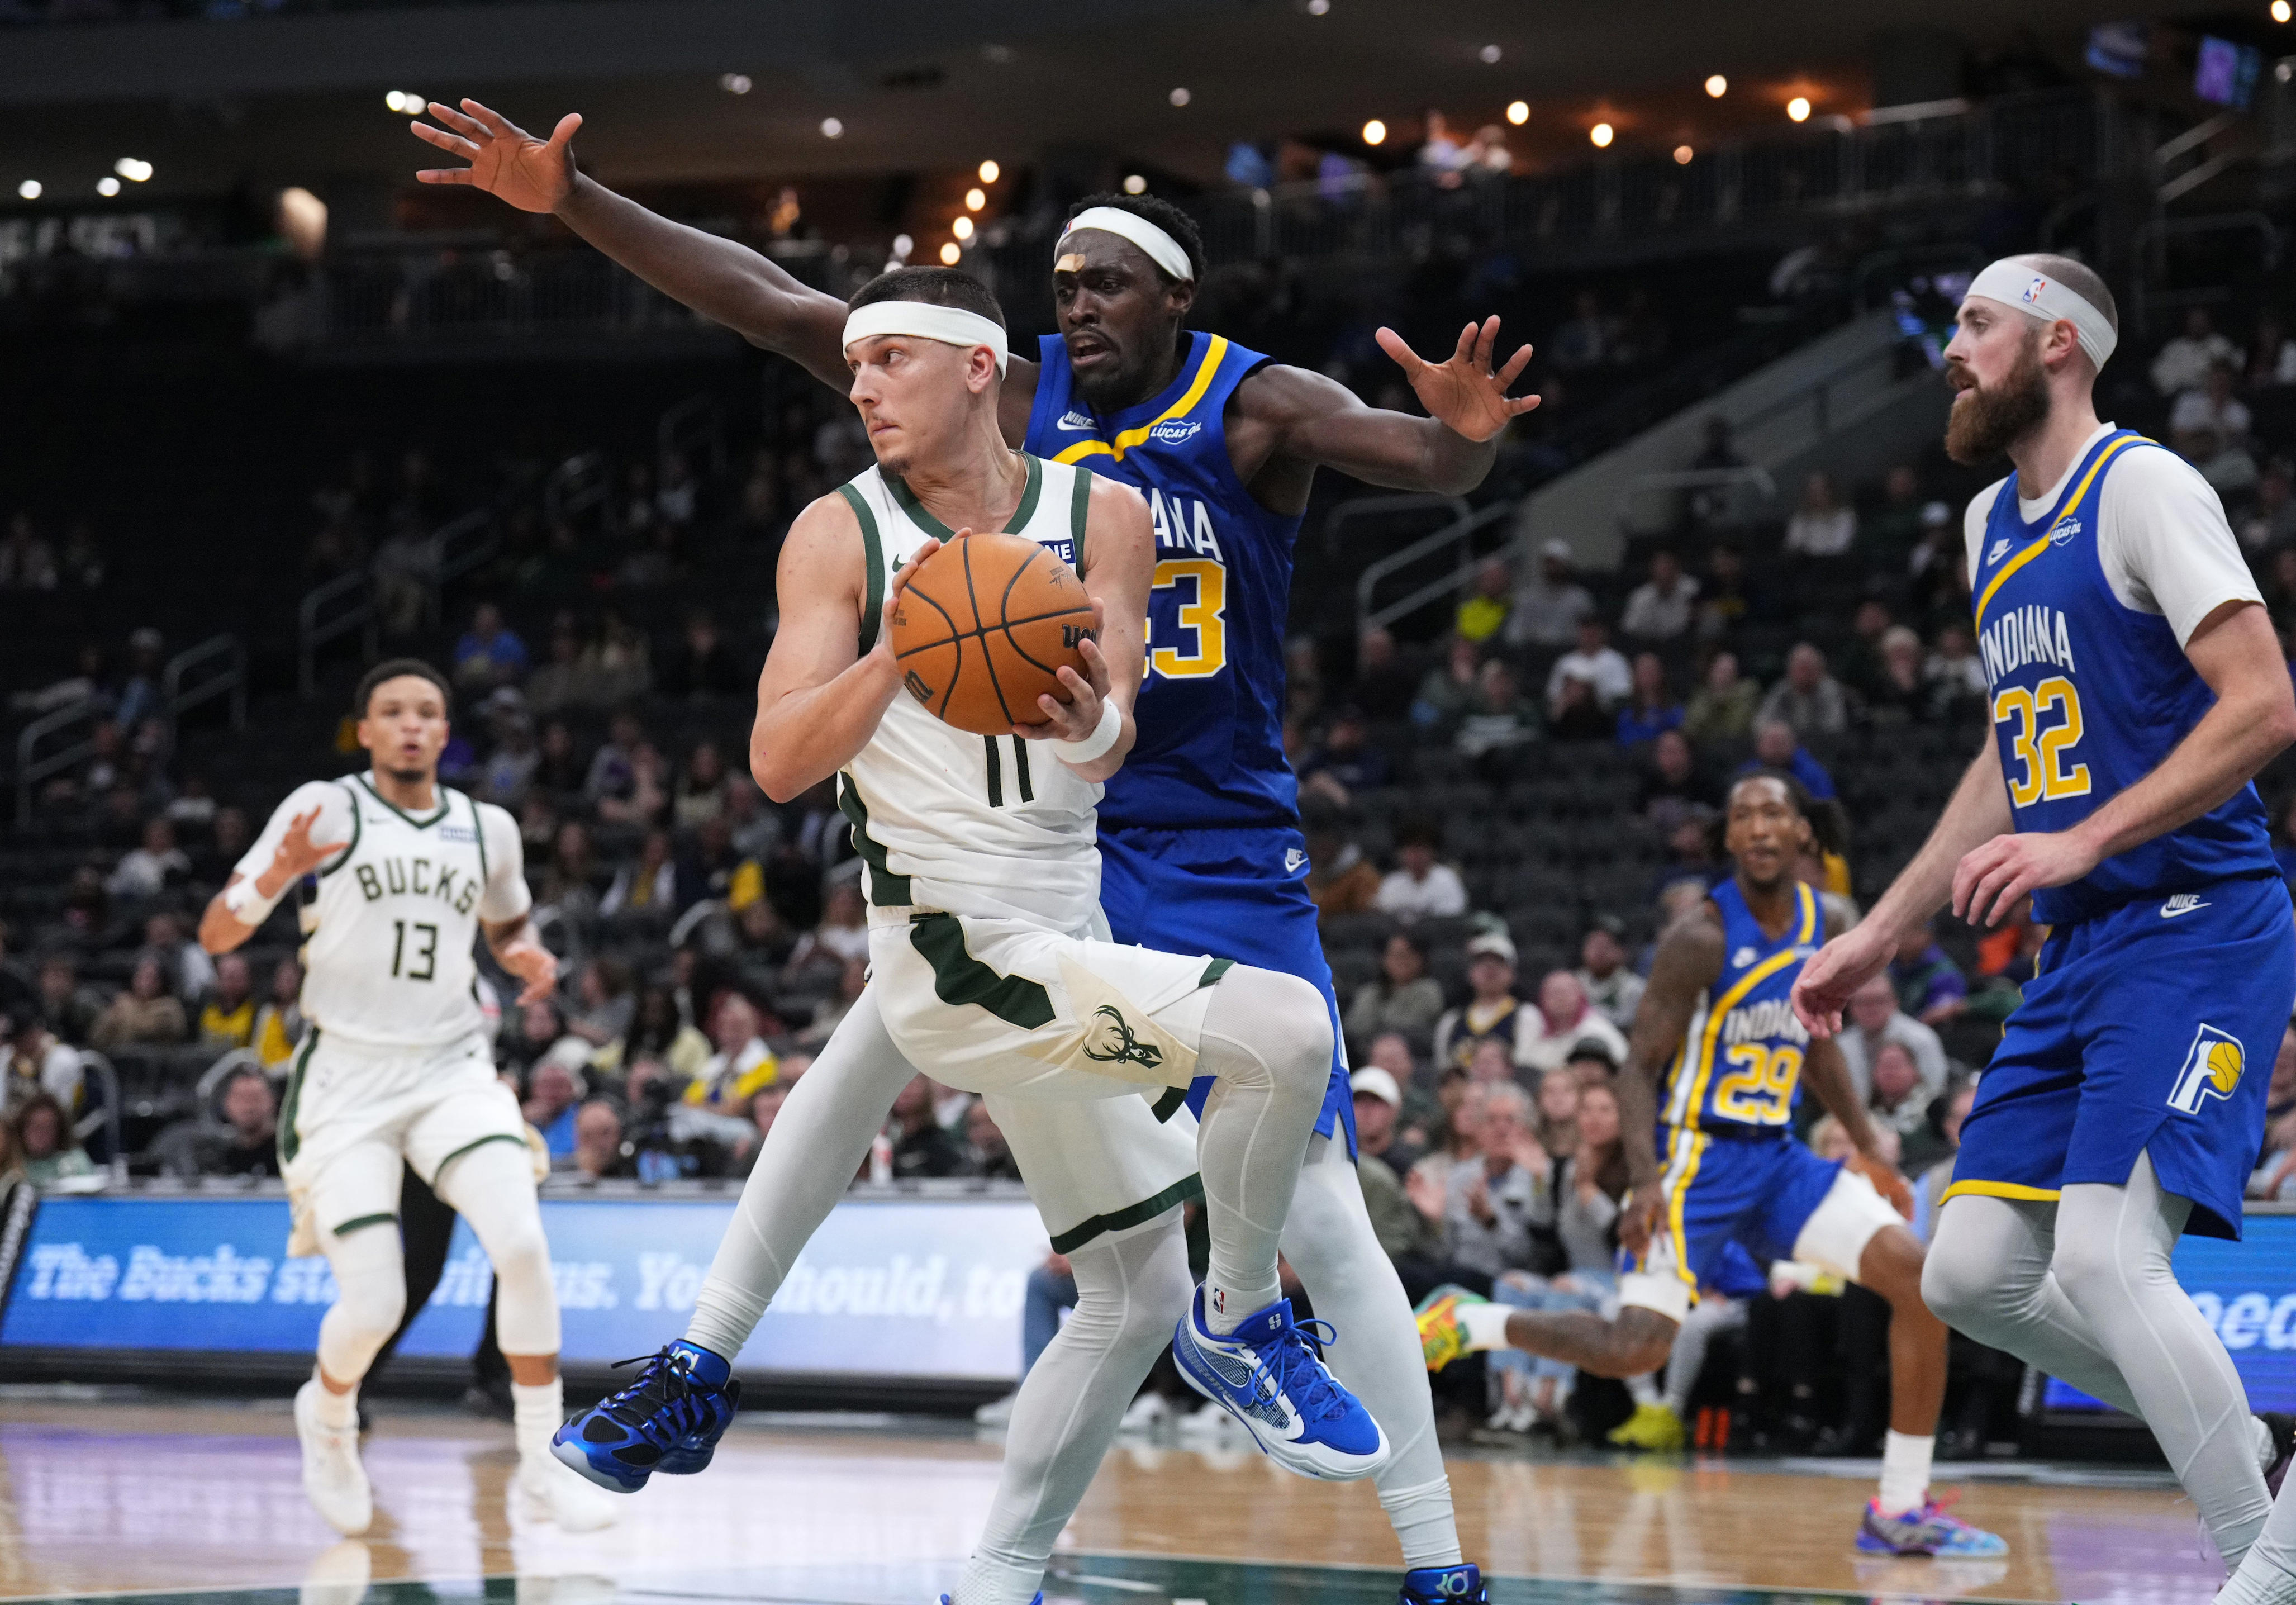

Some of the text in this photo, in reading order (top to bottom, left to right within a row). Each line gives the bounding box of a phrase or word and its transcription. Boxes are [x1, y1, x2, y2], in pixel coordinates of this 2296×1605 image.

[1064, 410, 1094, 427] NIKE
[1150, 426, 1187, 439] LUCAS
[1134, 486, 1224, 562] ANA
[2049, 525, 2072, 542] LUCAS
[1143, 557, 1227, 680] 3
[983, 733, 1035, 808] 11
[1993, 675, 2092, 810] 32
[356, 856, 478, 917] BUCKS
[2167, 894, 2200, 909] NIKE
[391, 919, 438, 982] 13
[1713, 1042, 1804, 1125] 29
[28, 1242, 118, 1300] The
[120, 1244, 273, 1303] Bucks
